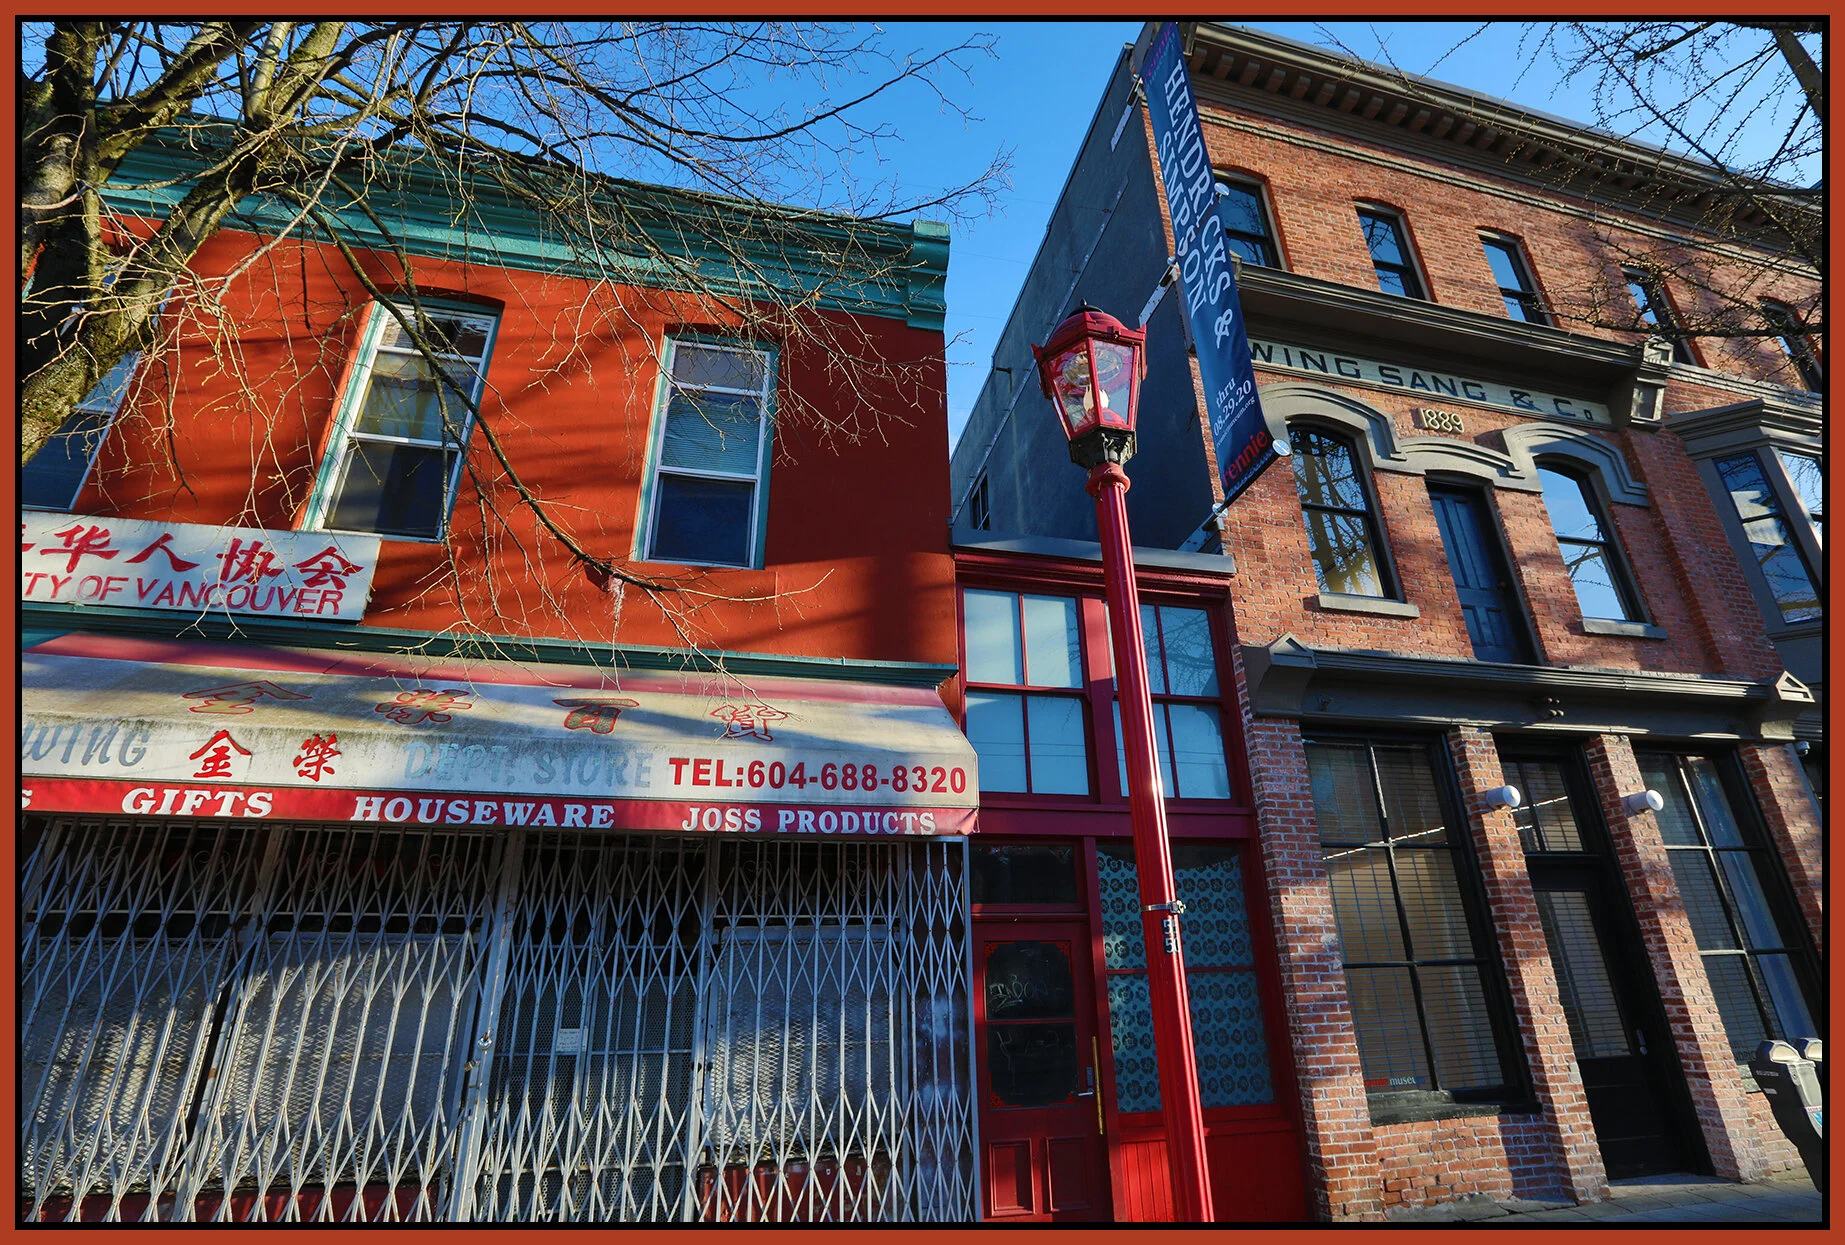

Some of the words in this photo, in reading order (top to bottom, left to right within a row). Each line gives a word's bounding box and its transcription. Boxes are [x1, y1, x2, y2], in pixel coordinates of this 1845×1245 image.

[1159, 130, 1207, 320] SIMPSON
[1164, 59, 1231, 306] HENDRICKS
[1214, 308, 1233, 349] &
[1215, 377, 1237, 408] thru
[1249, 342, 1361, 379] WING
[1377, 364, 1487, 402] SANG
[1508, 390, 1543, 413] &
[1213, 380, 1252, 437] 08.29.20
[1418, 407, 1465, 434] 1889
[1222, 431, 1269, 487] rennie
[22, 524, 365, 590] 华人协会
[76, 575, 130, 600] OF
[136, 577, 344, 616] VANCOUVER
[533, 749, 654, 788] STORE
[668, 756, 967, 794] TEL:604-688-8320
[121, 787, 274, 819] GIFTS
[351, 795, 616, 830] HOUSEWARE
[681, 806, 762, 833] JOSS
[777, 808, 937, 836] PRODUCTS
